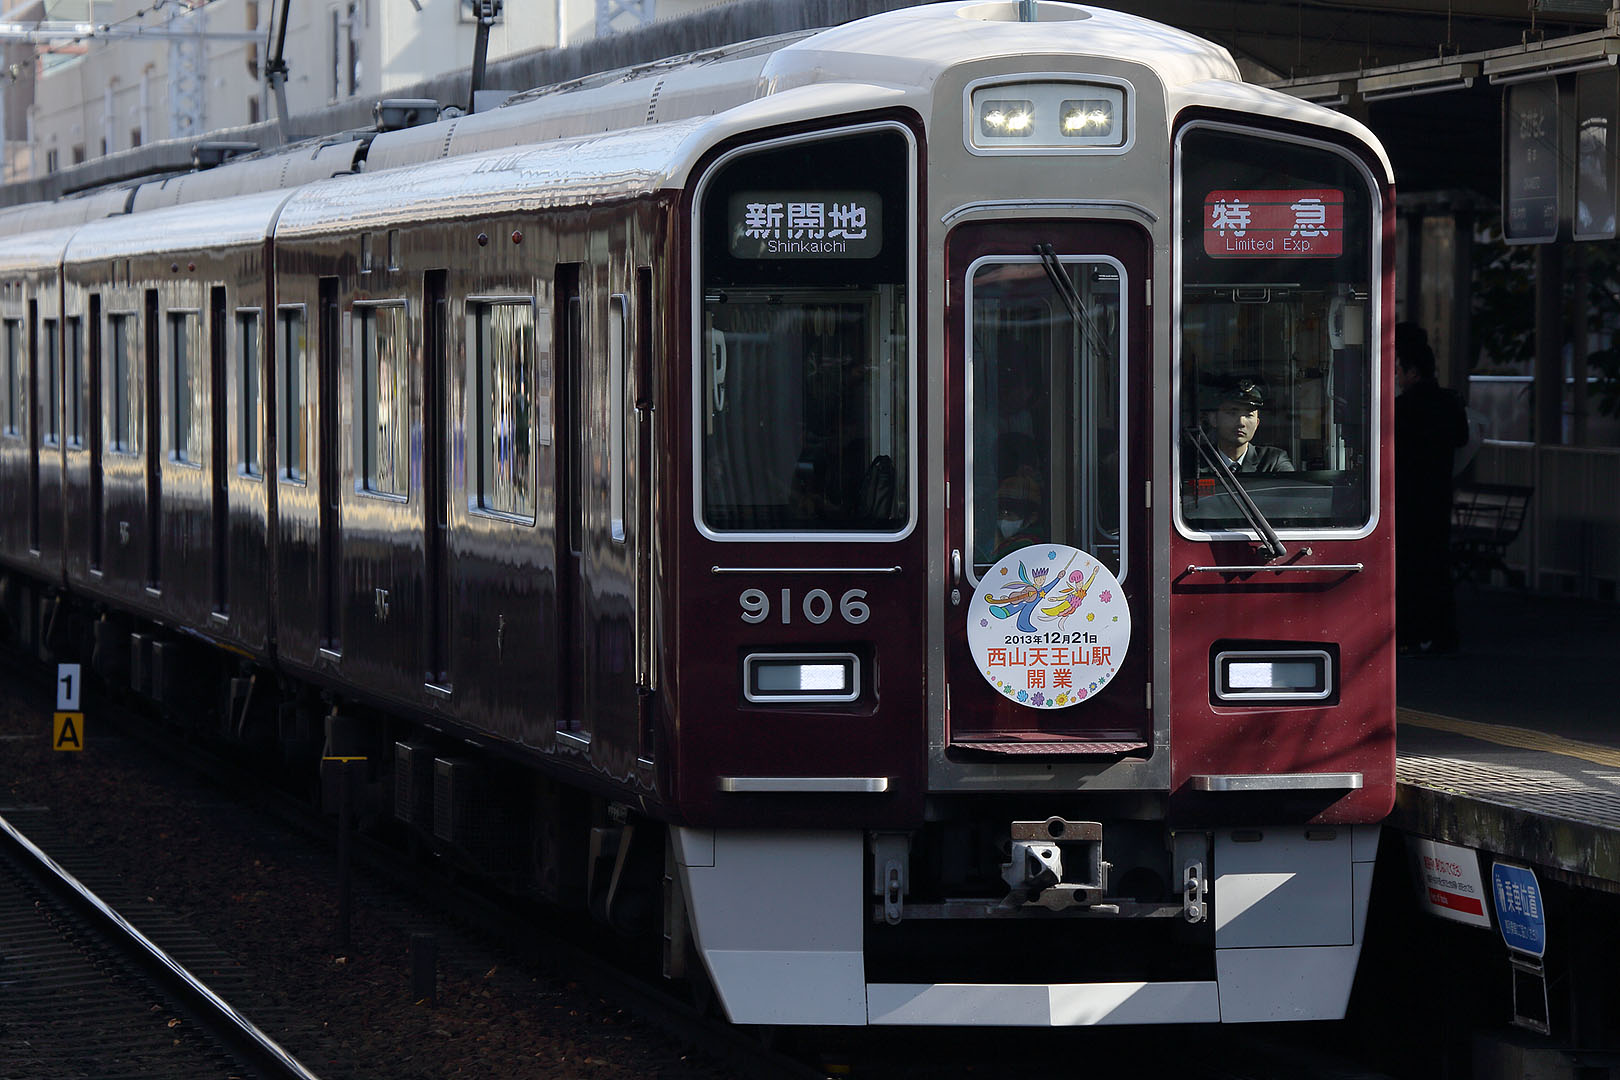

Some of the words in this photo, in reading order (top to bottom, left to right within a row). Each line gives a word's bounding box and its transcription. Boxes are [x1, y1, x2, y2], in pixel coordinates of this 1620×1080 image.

[745, 202, 868, 239] 新開地
[1212, 198, 1329, 237] 特急
[767, 239, 846, 253] Shinkaichi
[1226, 238, 1275, 251] Limited
[1283, 238, 1314, 252] Exp.
[739, 588, 871, 625] 9106
[1004, 631, 1098, 645] 2013年12月21日
[987, 646, 1112, 667] 西山天王山駅
[60, 674, 73, 700] 1
[1027, 669, 1073, 689] 開業
[56, 717, 80, 748] A
